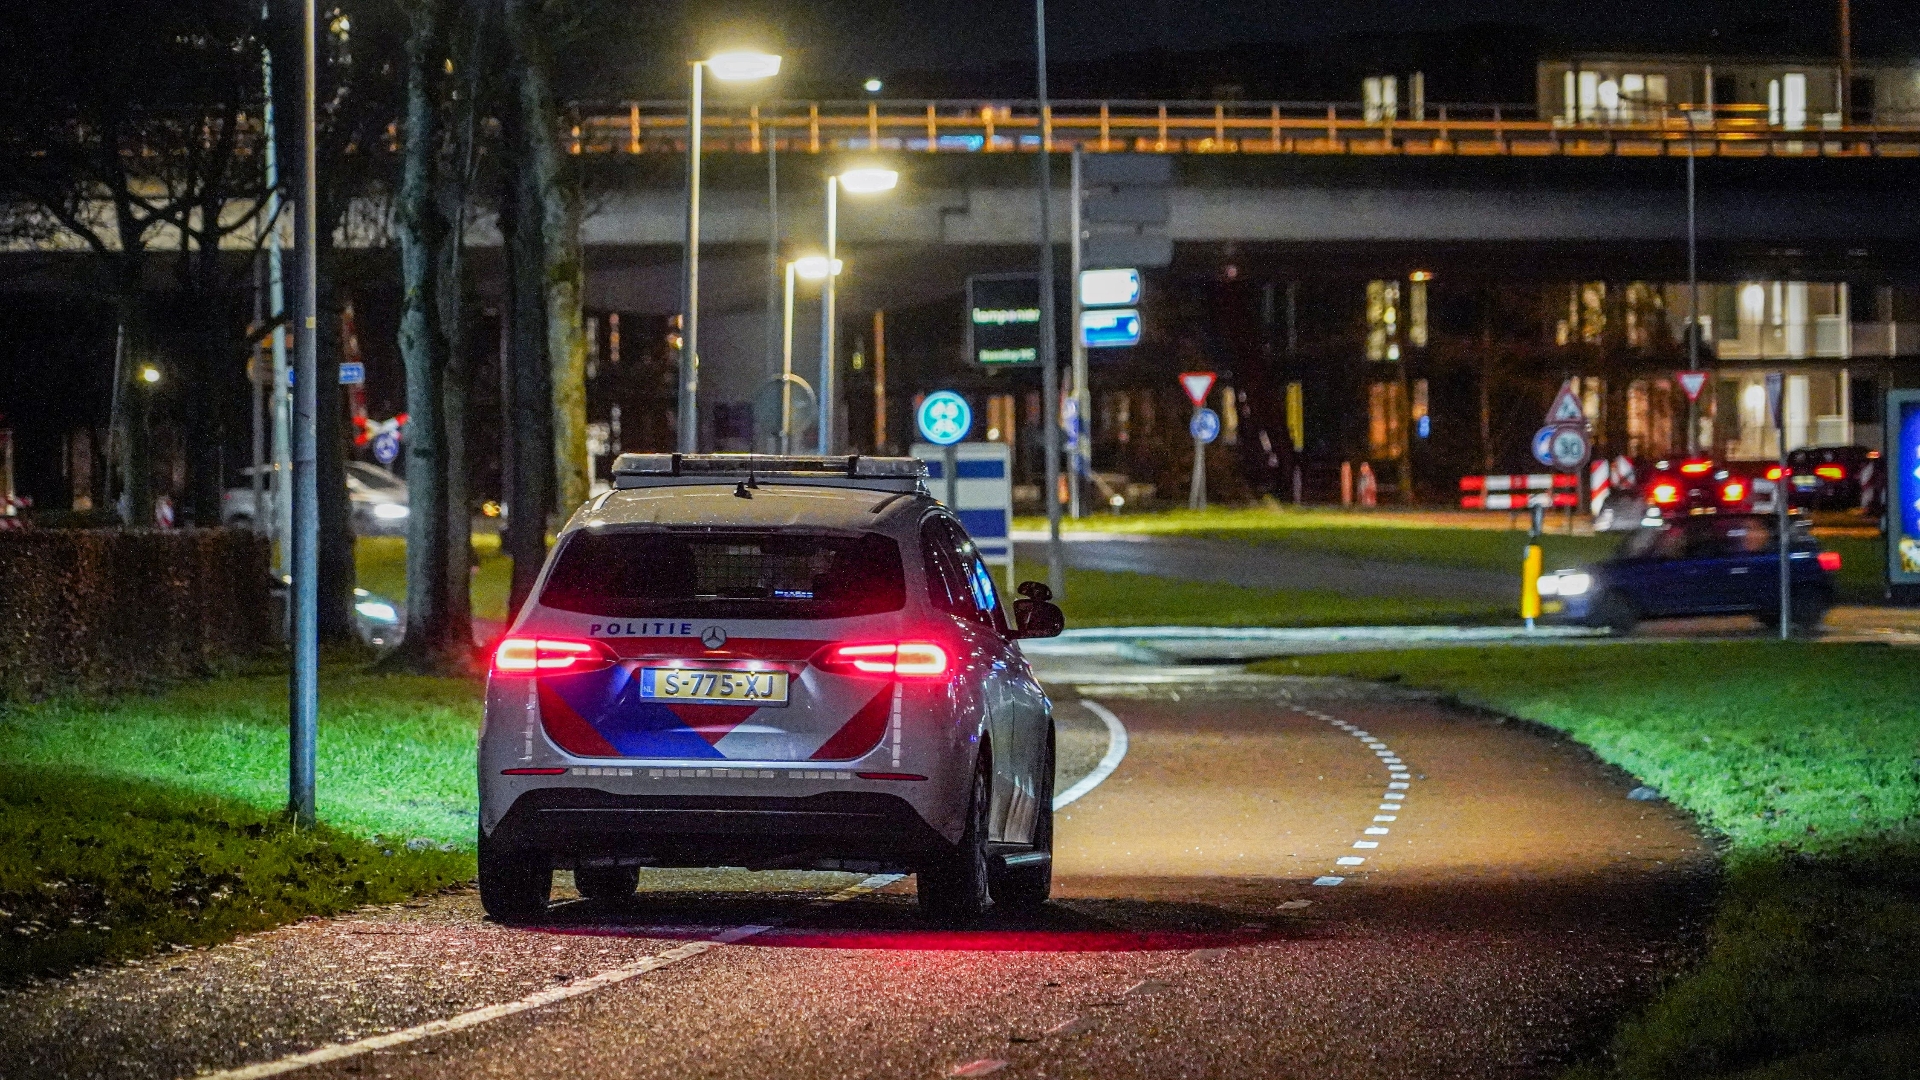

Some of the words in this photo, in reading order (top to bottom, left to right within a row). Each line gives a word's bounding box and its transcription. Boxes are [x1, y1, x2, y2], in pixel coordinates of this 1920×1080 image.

[1560, 436, 1581, 456] 30
[590, 623, 692, 636] POLITIE
[665, 673, 774, 697] S-775-XJ
